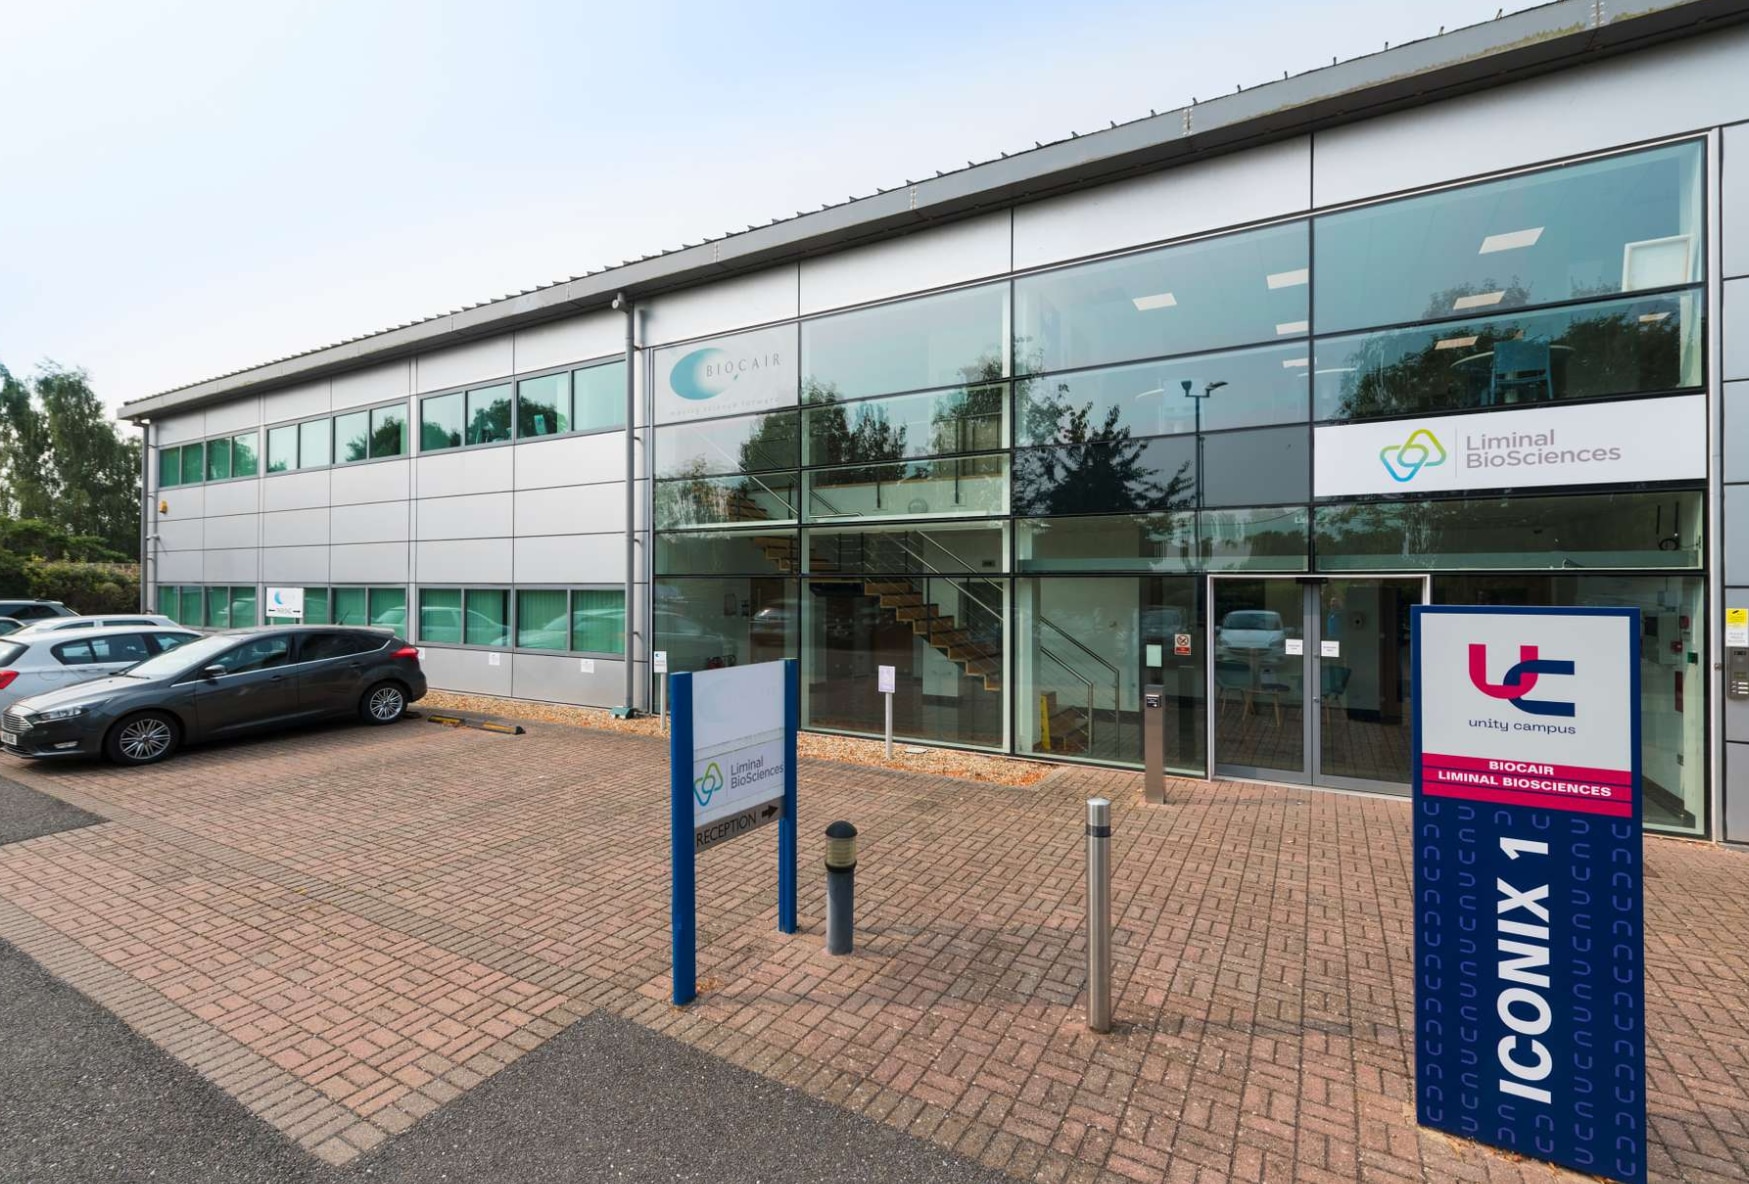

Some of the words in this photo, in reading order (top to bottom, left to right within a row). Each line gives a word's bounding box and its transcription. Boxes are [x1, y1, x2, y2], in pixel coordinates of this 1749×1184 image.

[706, 353, 781, 377] BIOCAIR
[1466, 429, 1555, 451] Liminal
[1466, 445, 1622, 469] BioSciences
[1468, 717, 1509, 732] unity
[1513, 720, 1577, 736] campus
[731, 756, 764, 776] Liminal
[731, 764, 783, 788] BioSciences
[1489, 760, 1554, 776] BIOCAIR
[1437, 770, 1499, 786] LIMINAL
[1503, 777, 1613, 797] BIOSCIENCES
[695, 811, 757, 846] RECEPTION
[1499, 836, 1549, 862] 1
[1496, 877, 1553, 1105] ICONIX
